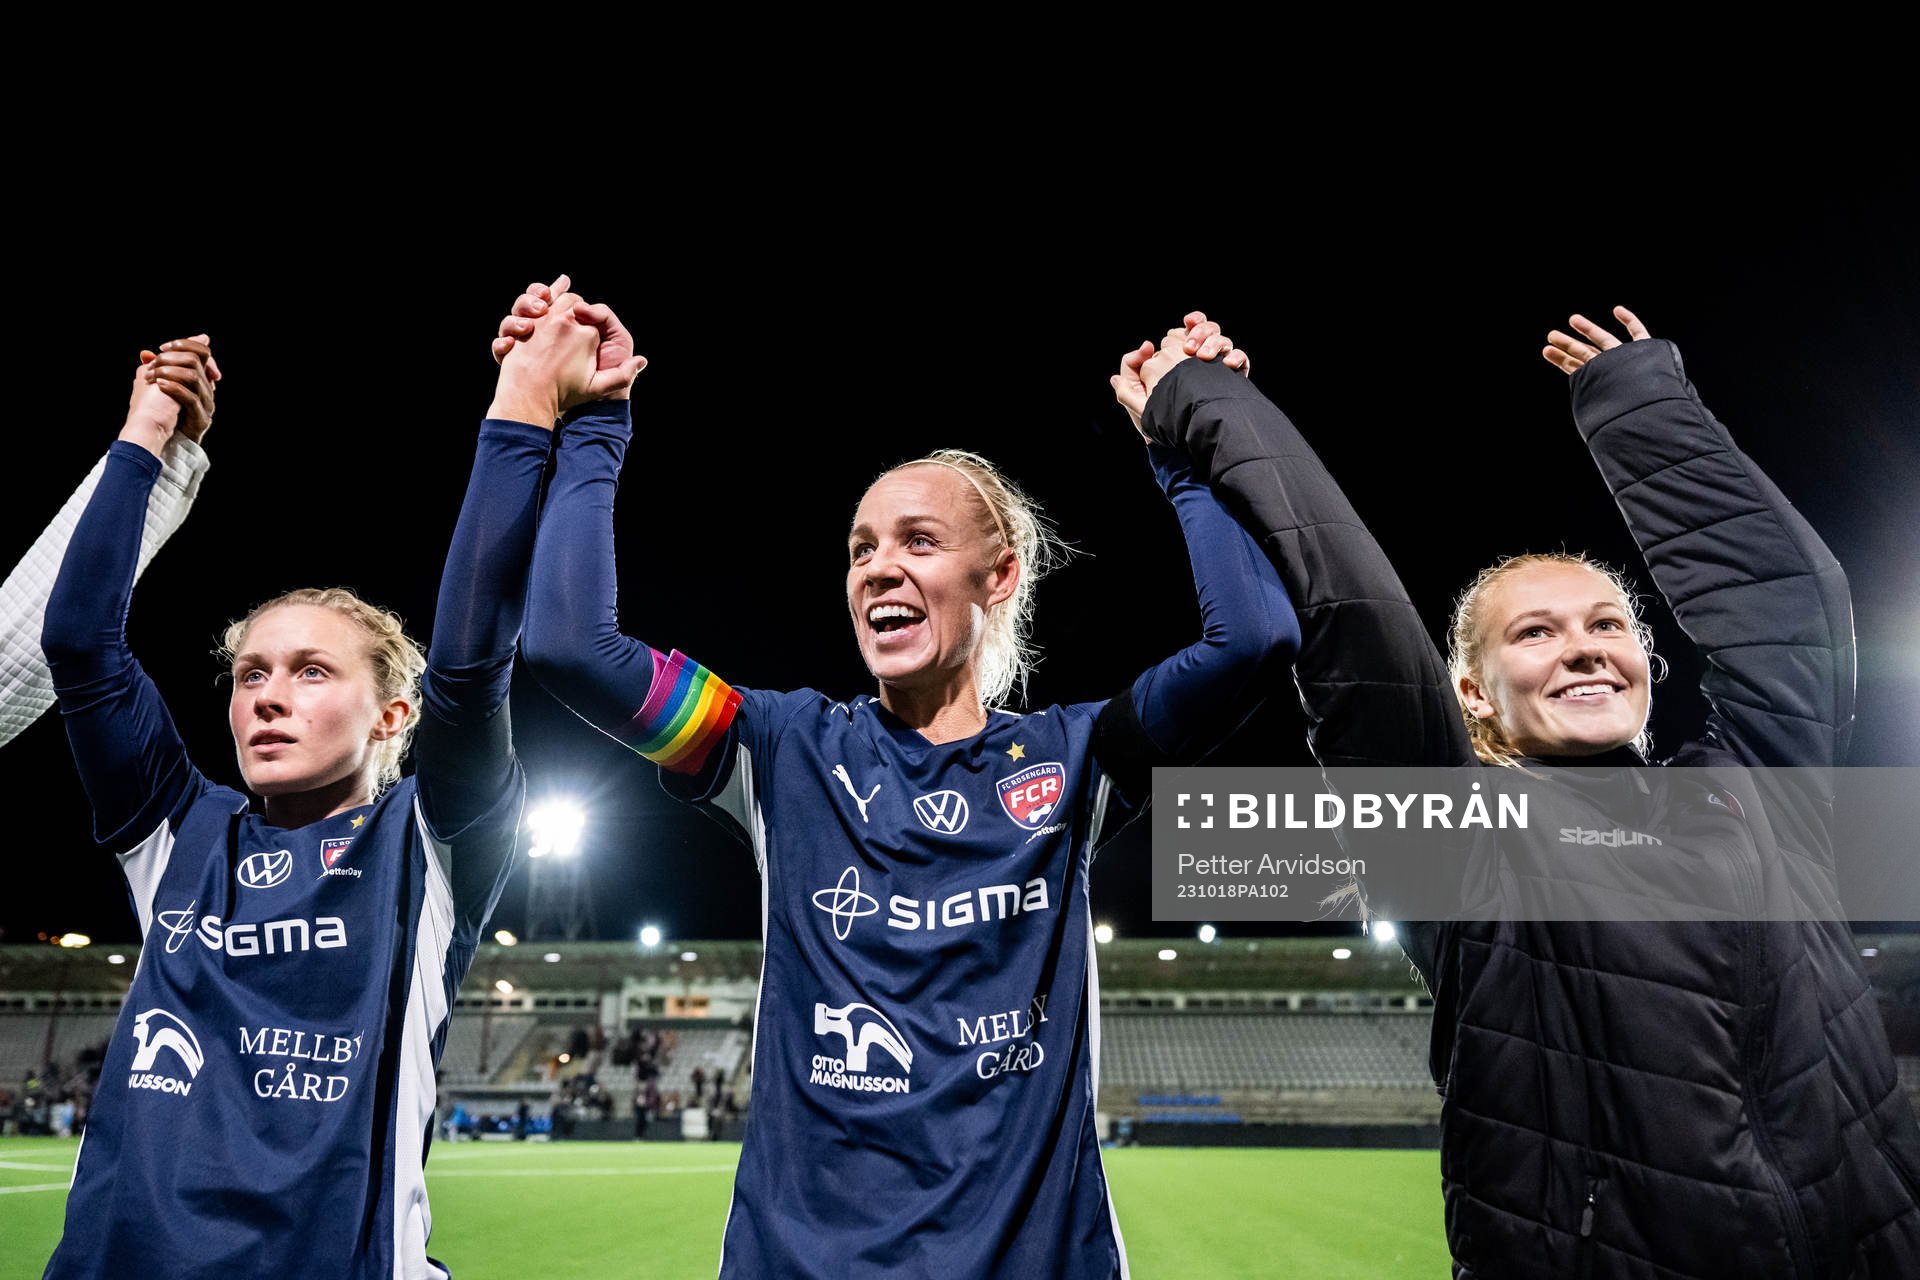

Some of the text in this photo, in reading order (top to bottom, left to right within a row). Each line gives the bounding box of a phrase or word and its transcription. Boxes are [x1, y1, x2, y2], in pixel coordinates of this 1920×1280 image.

[1001, 767, 1057, 791] FC ROSENGÅRD
[1010, 777, 1058, 809] FCR
[1559, 826, 1662, 848] stadium
[322, 867, 362, 879] etterDay
[812, 1055, 845, 1074] OTTO
[976, 1041, 1045, 1080] GÅRD
[128, 1073, 192, 1097] NUSSON
[254, 1062, 349, 1103] GÅRD
[809, 1071, 910, 1094] MAGNUSSON
